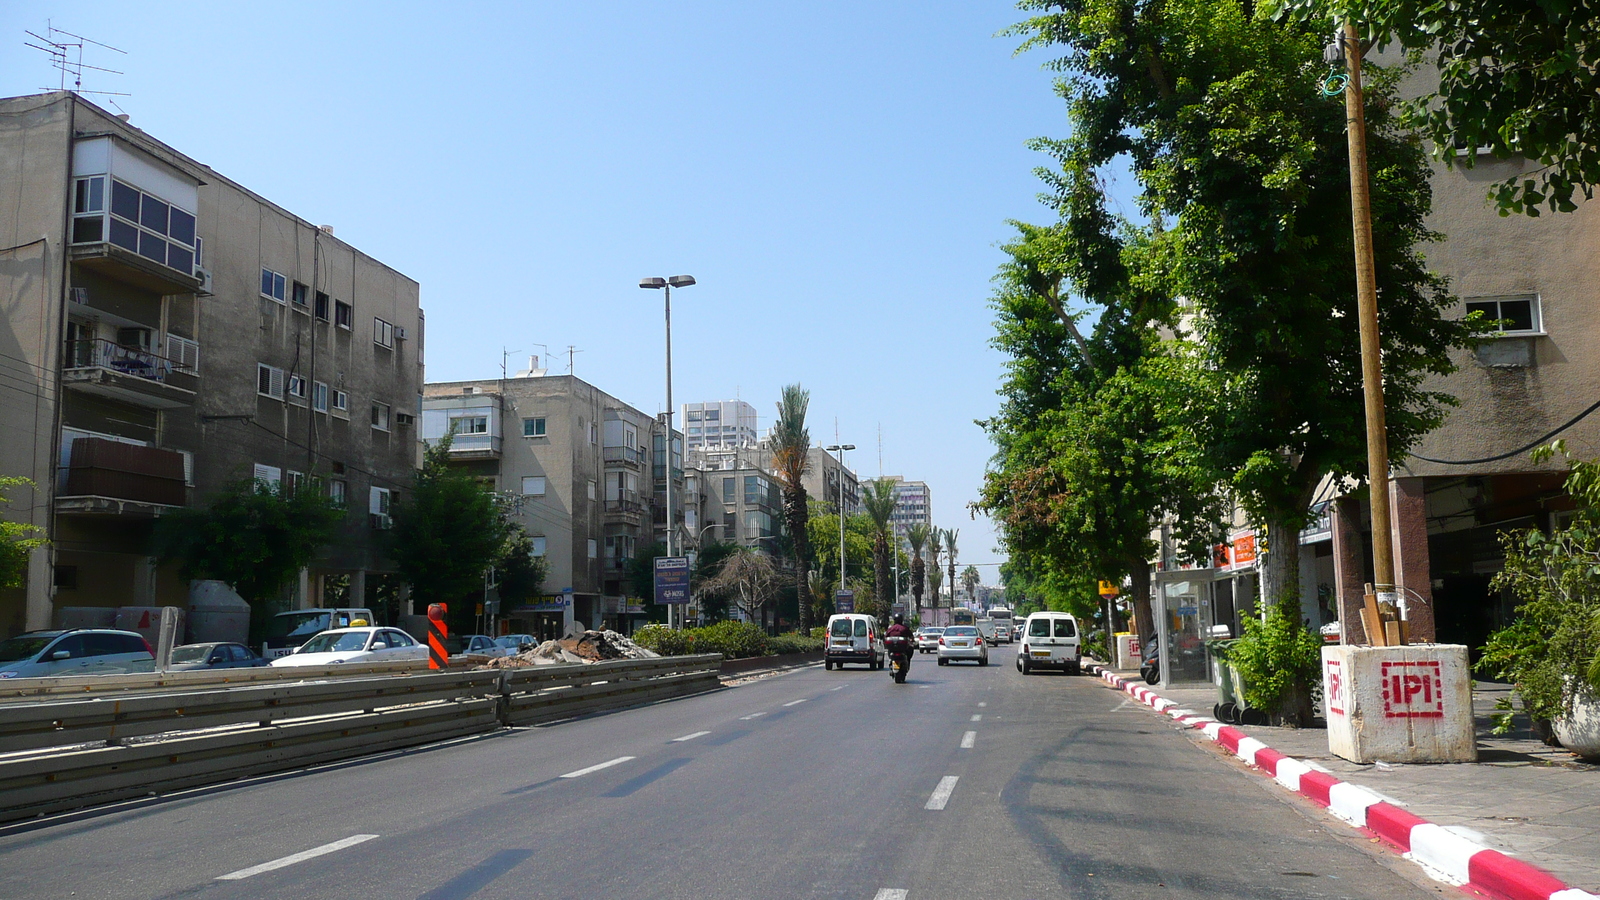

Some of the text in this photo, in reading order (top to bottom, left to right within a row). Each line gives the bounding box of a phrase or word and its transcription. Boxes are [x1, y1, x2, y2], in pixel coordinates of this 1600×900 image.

[274, 649, 294, 657] ISU
[1330, 673, 1341, 700] IPI
[1392, 674, 1432, 704] IPI
